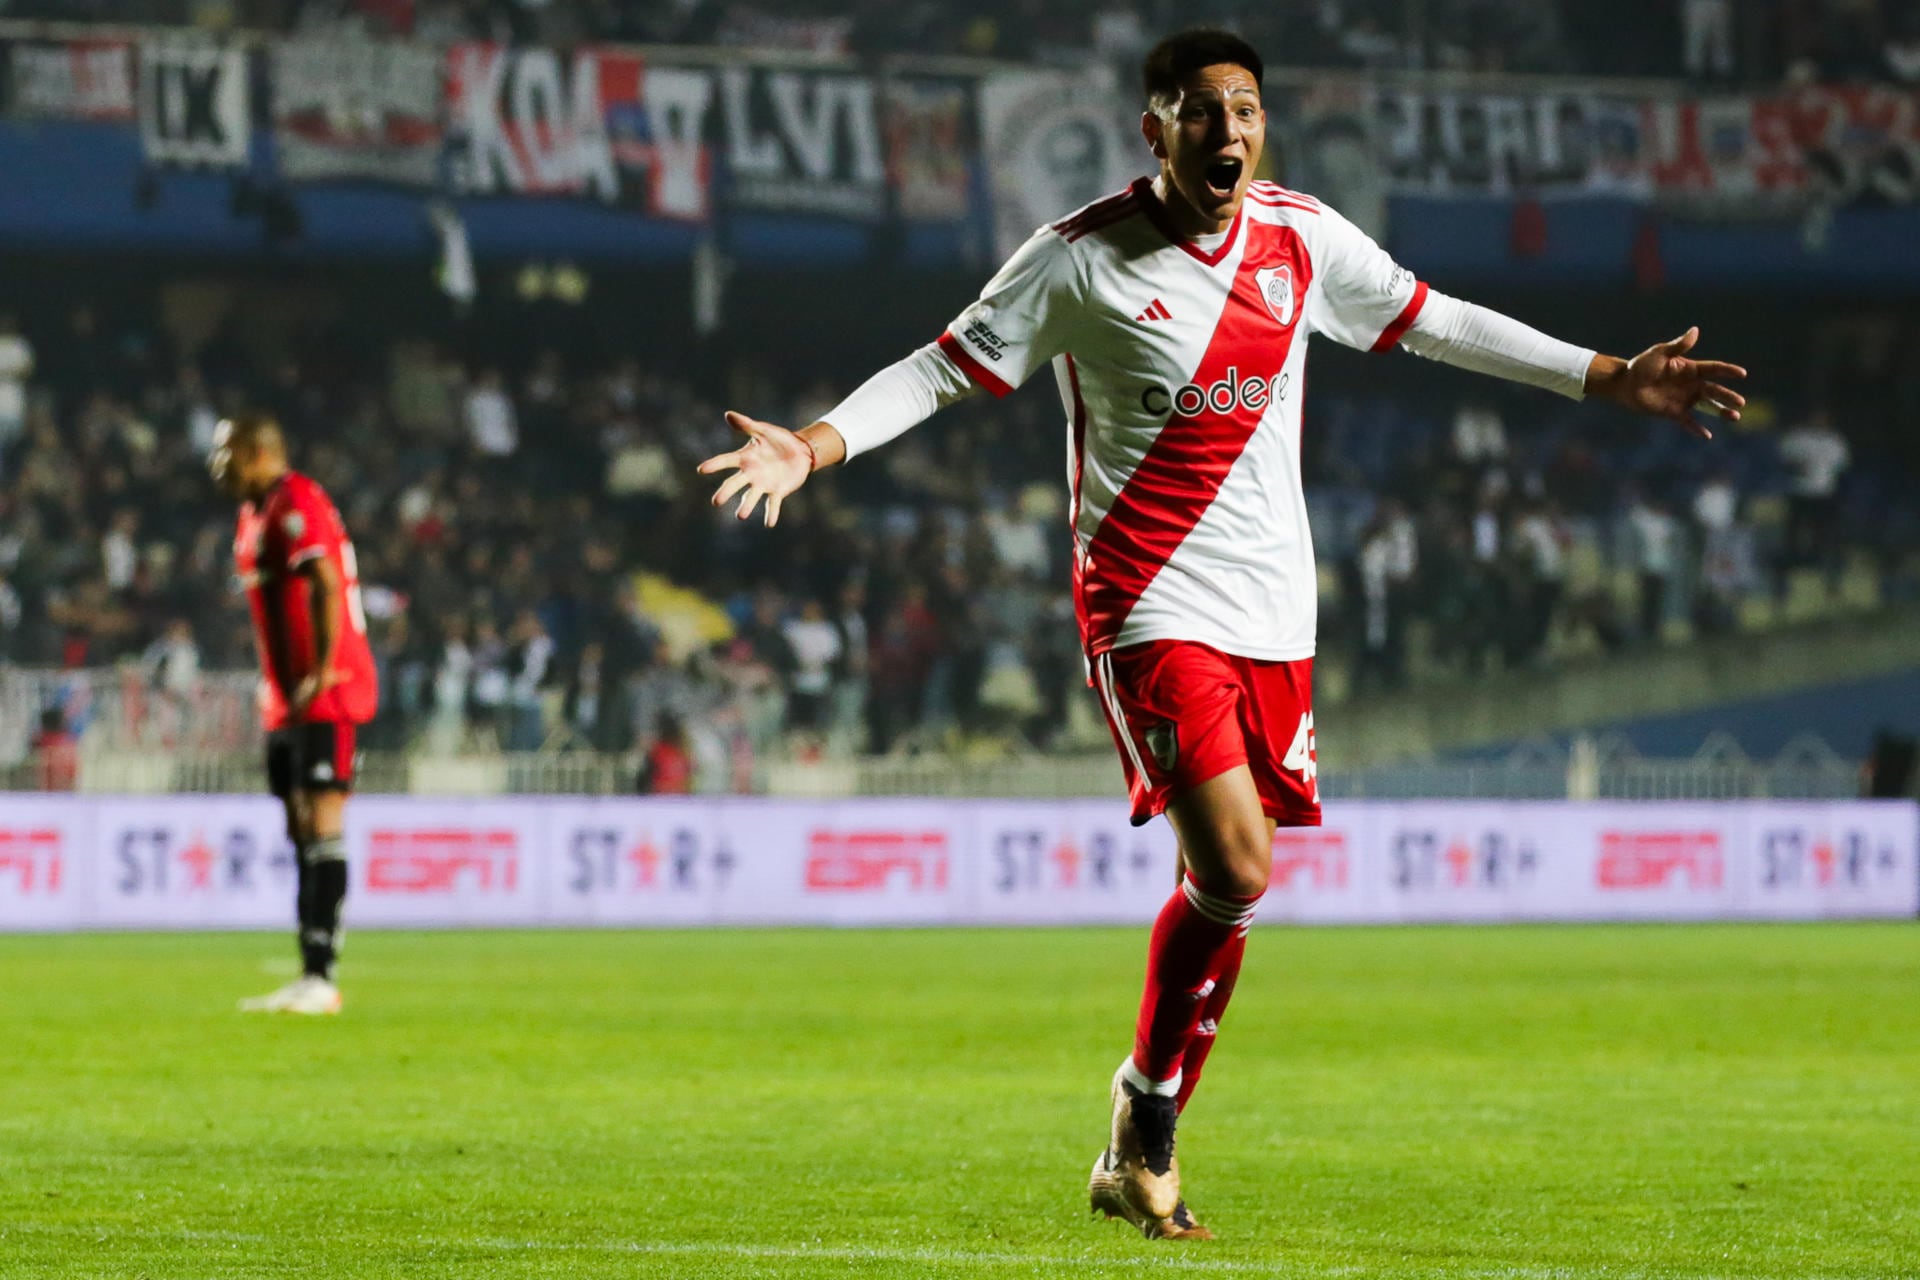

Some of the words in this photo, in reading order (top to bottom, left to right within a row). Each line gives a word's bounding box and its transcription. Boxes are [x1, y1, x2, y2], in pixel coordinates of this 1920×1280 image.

[1141, 366, 1289, 418] codere
[366, 831, 518, 891] ESPN
[806, 832, 948, 889] ESPN
[1595, 831, 1724, 888] ESPN
